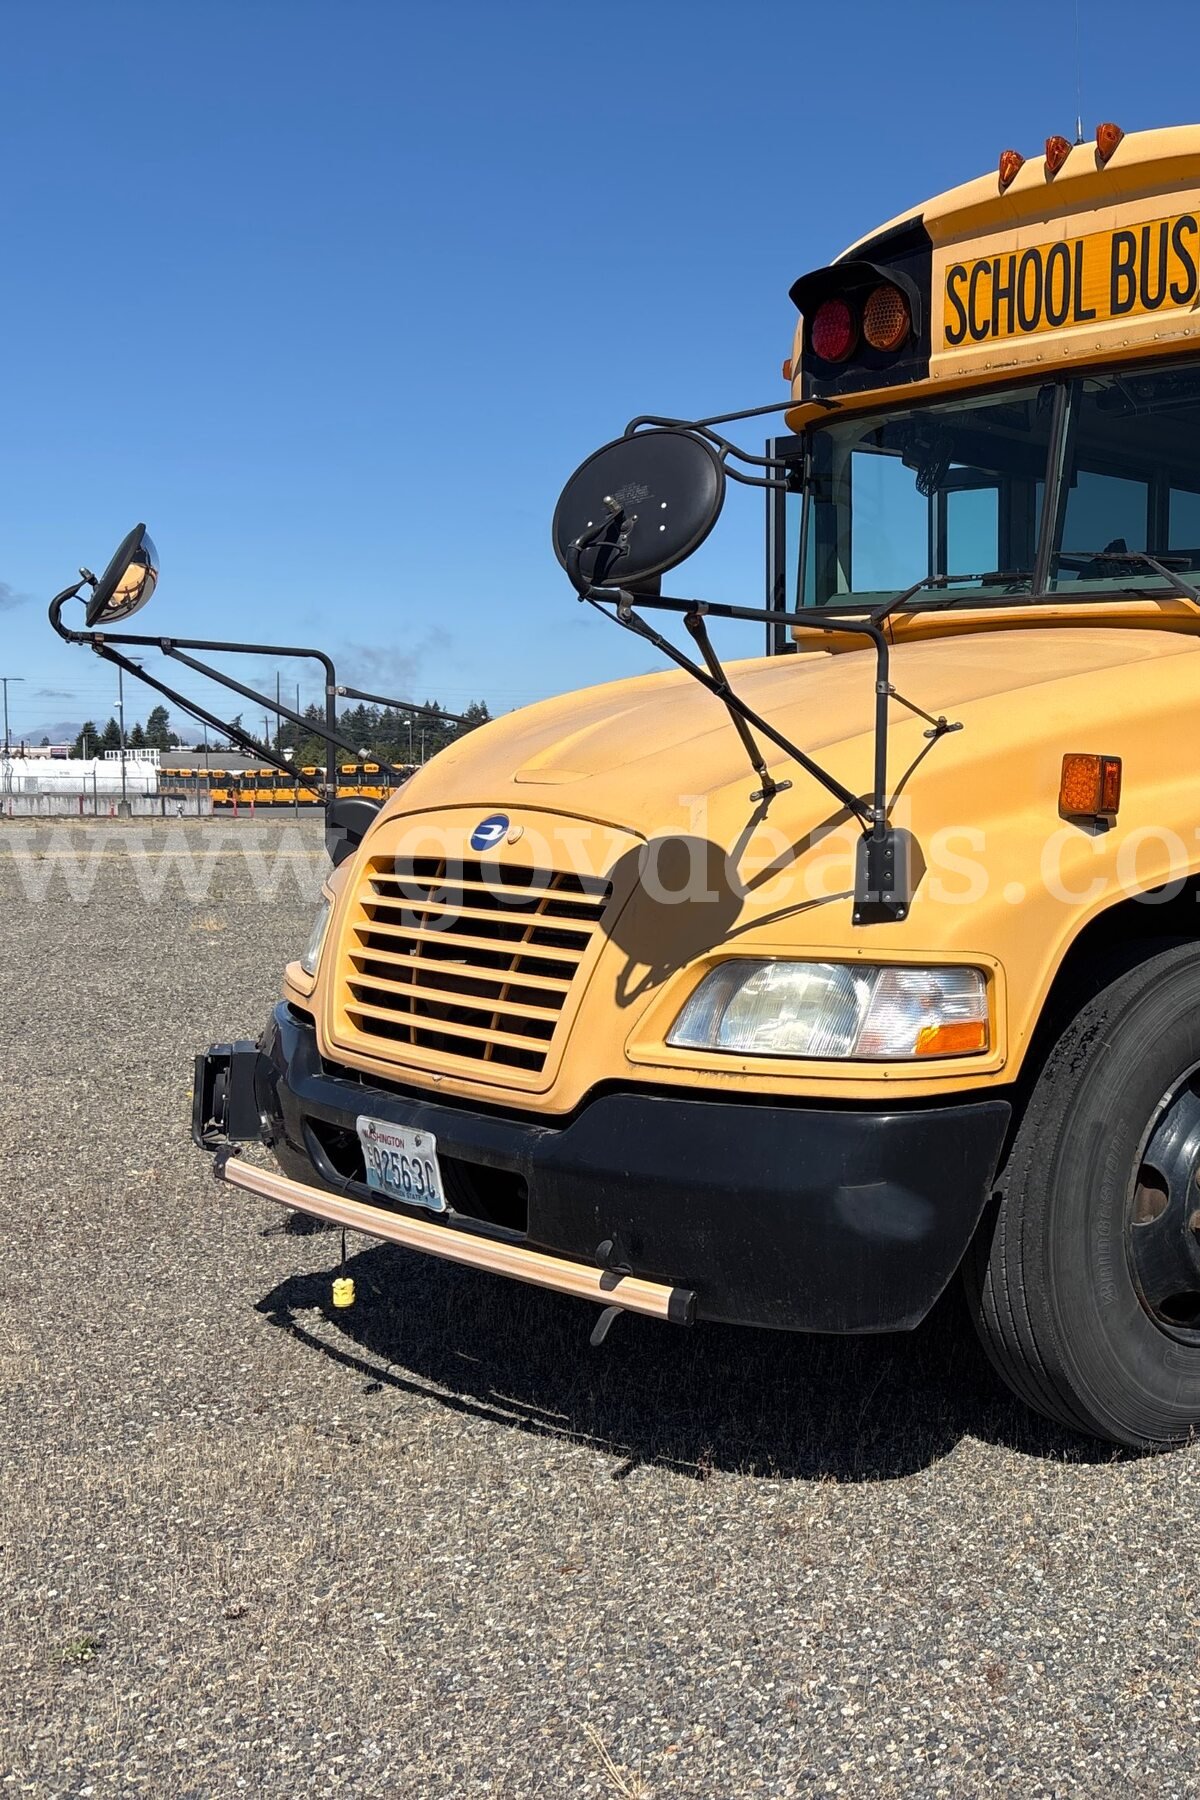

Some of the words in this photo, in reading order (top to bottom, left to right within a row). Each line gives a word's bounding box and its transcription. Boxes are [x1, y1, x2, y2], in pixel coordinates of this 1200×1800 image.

[945, 240, 1096, 345] SCHOOL
[1110, 215, 1198, 316] BUS
[362, 1127, 405, 1149] WASHINGTON
